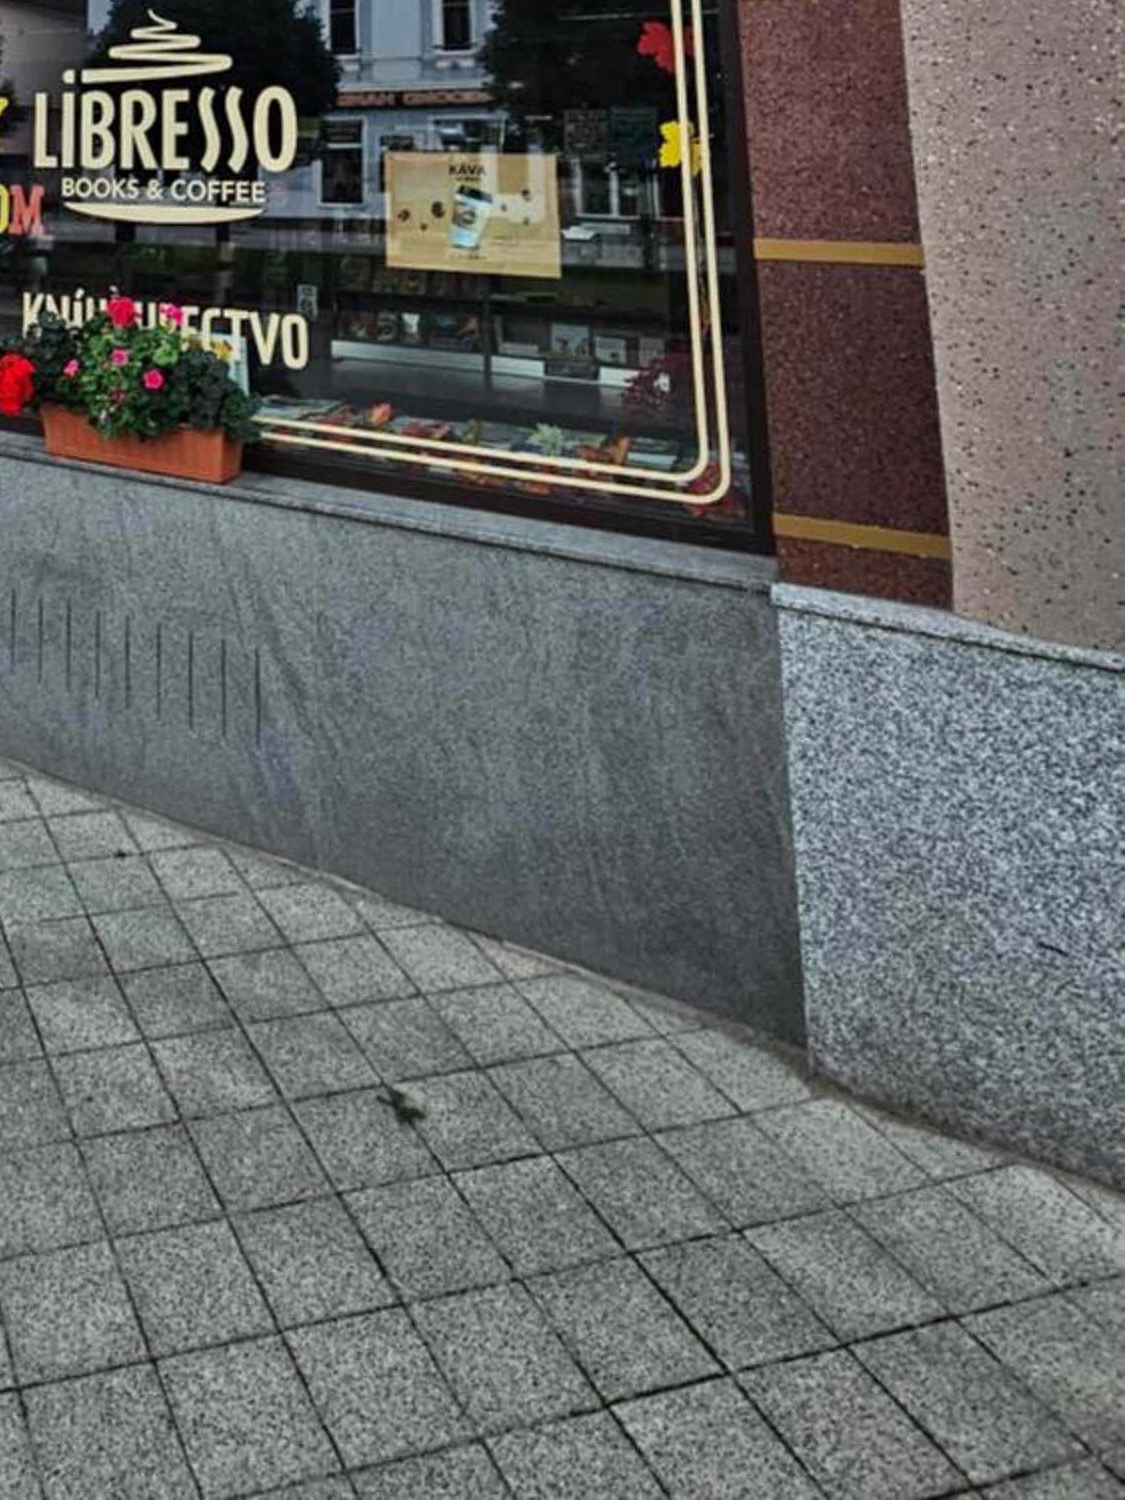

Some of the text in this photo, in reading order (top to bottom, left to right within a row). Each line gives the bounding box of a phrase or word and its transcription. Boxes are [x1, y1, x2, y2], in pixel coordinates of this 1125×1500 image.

[61, 177, 267, 203] BOOKS & COFFEE
